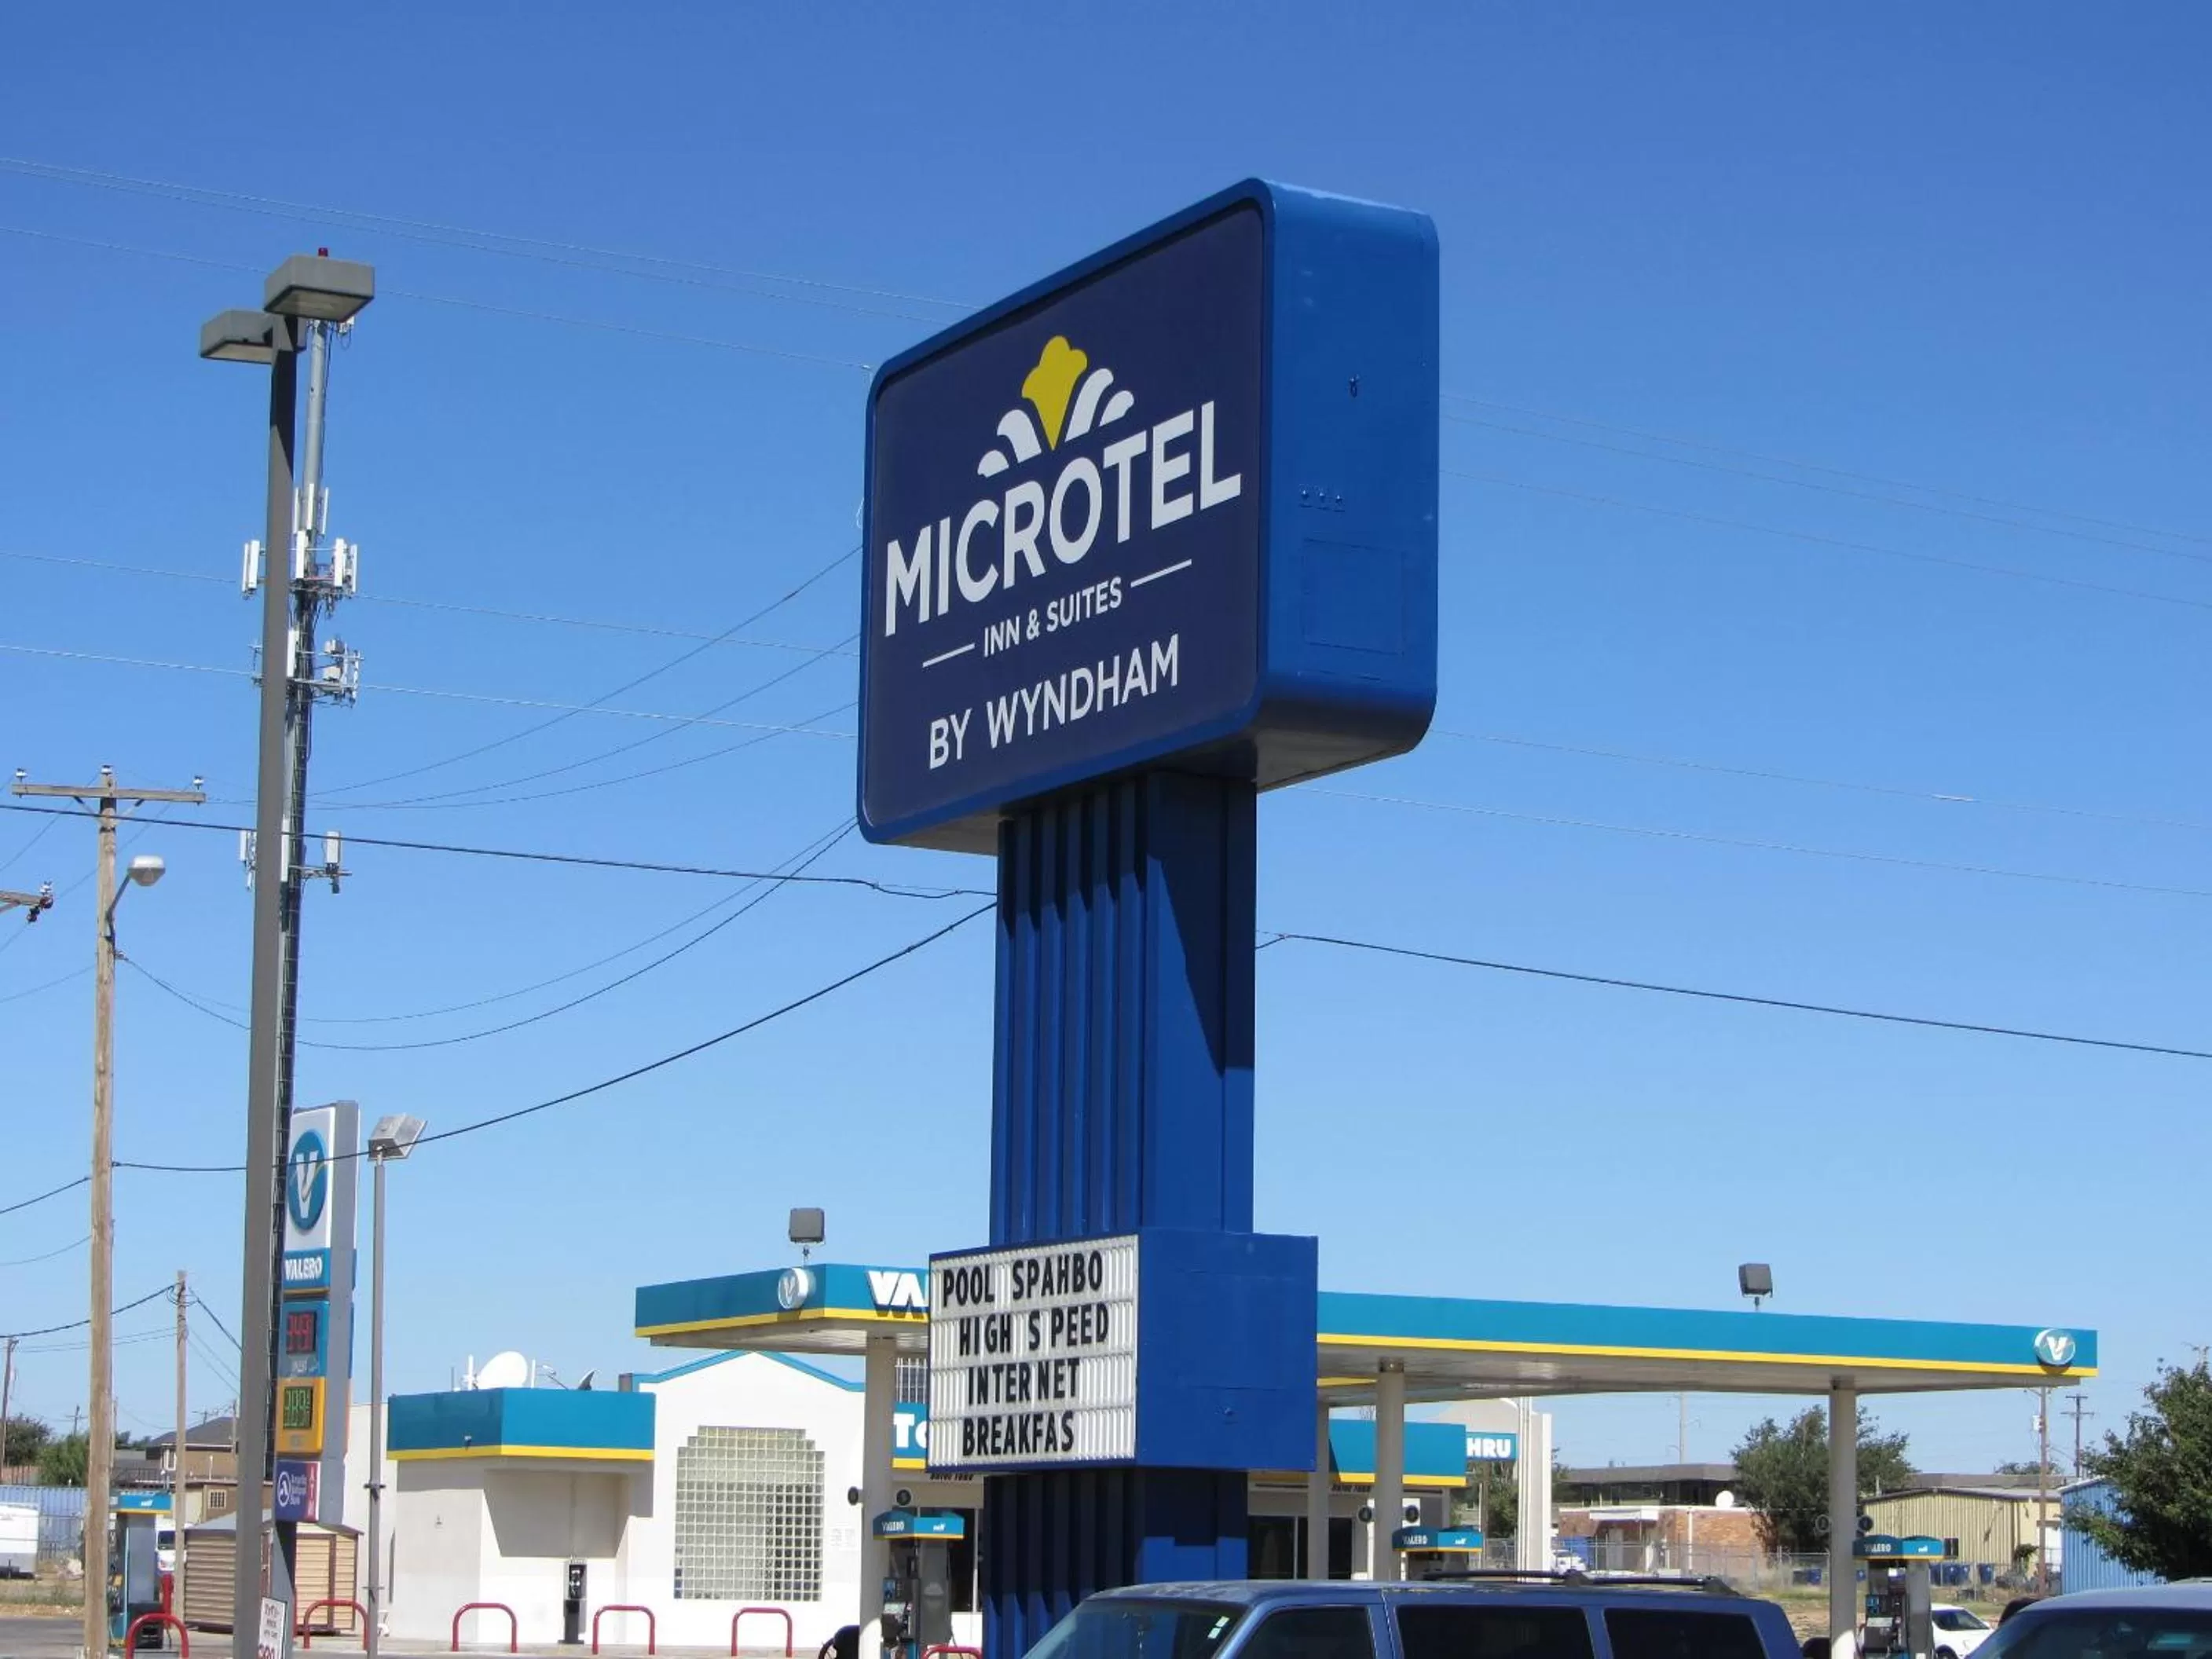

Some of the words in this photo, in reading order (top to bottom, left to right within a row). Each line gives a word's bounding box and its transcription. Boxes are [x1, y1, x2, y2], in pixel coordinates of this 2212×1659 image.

[885, 401, 1241, 636] MICROTEL
[984, 616, 1020, 657] INN
[1026, 610, 1040, 640] &
[1046, 576, 1122, 632] SUITES
[929, 709, 972, 770] BY
[986, 633, 1178, 749] WYNDHAM
[285, 1257, 323, 1280] VALERO
[867, 1270, 930, 1307] VA
[943, 1264, 995, 1308] POOL
[1012, 1250, 1104, 1301] SPAHBO
[959, 1313, 1012, 1357] HIGH
[968, 1357, 1080, 1405] INTERNET
[962, 1410, 1074, 1456] BREAKFAS
